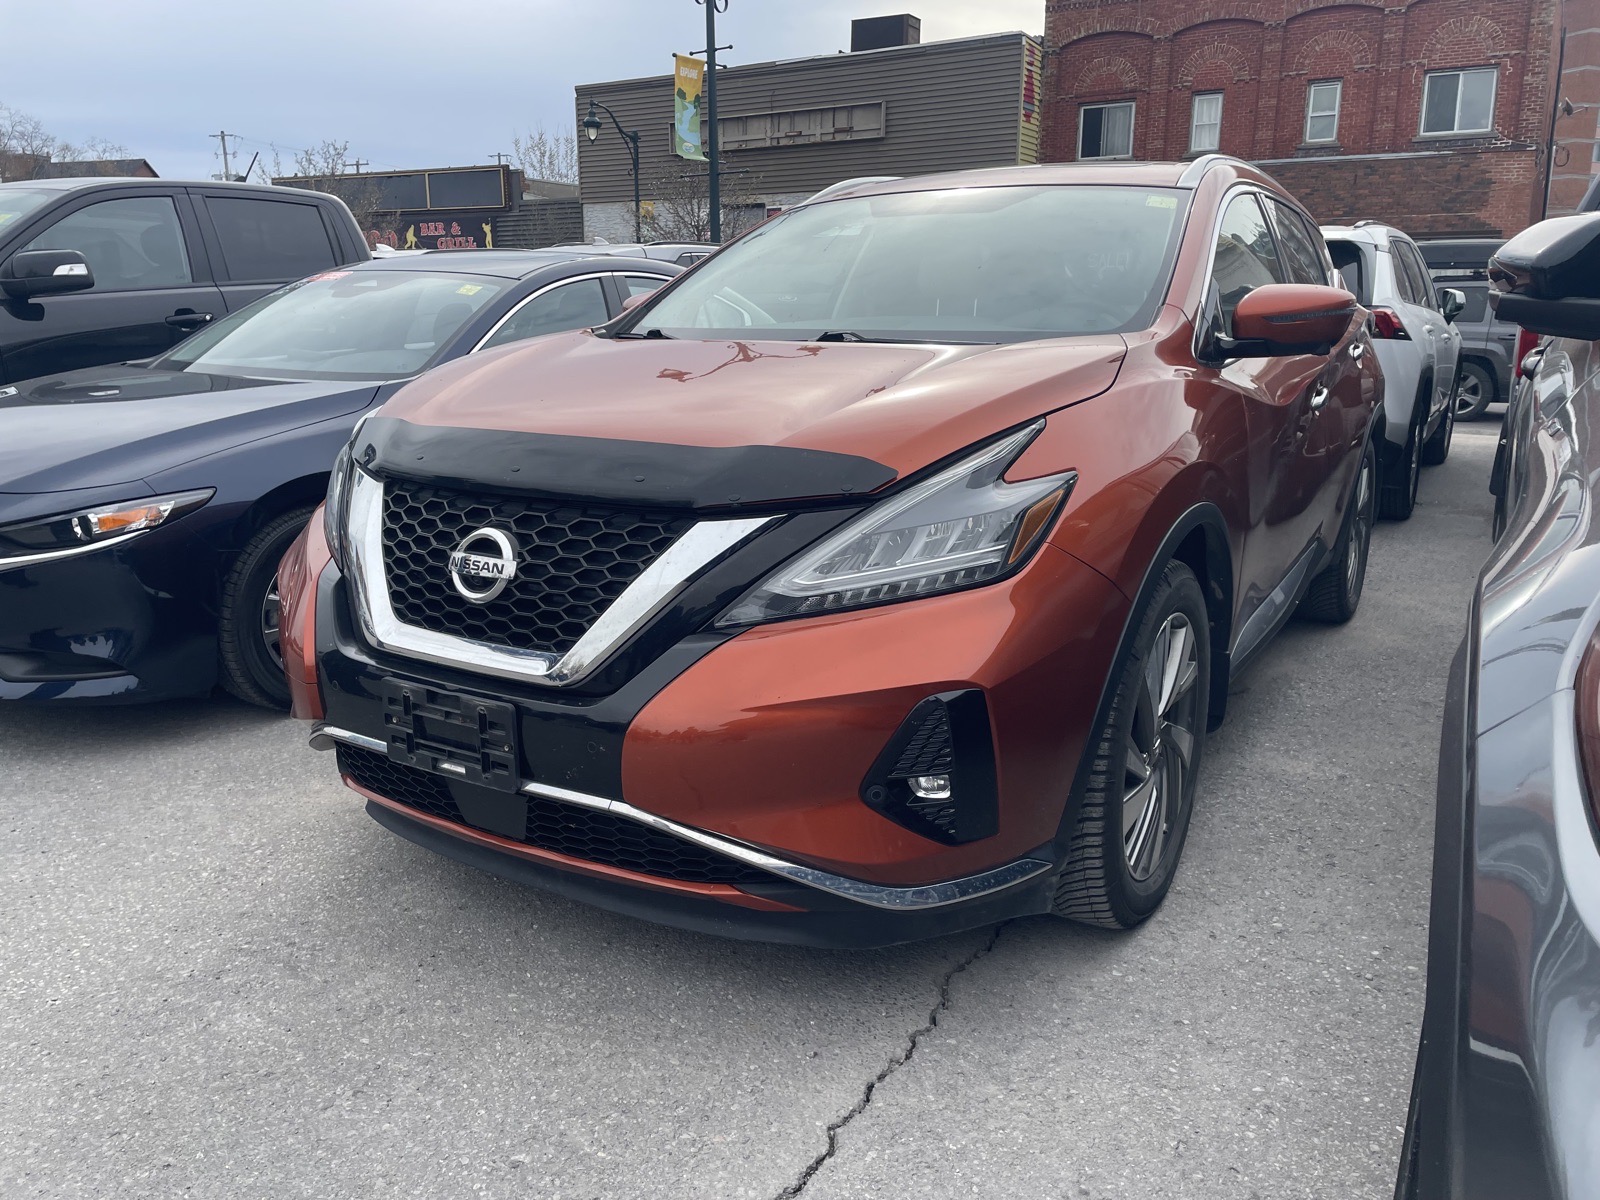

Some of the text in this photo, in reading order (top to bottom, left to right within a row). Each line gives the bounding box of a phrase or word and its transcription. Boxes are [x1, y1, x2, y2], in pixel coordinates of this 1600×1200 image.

[680, 67, 698, 80] EXPLORE
[420, 222, 461, 236] BAR &
[437, 237, 477, 250] GRILL
[450, 556, 505, 575] NISSAN
